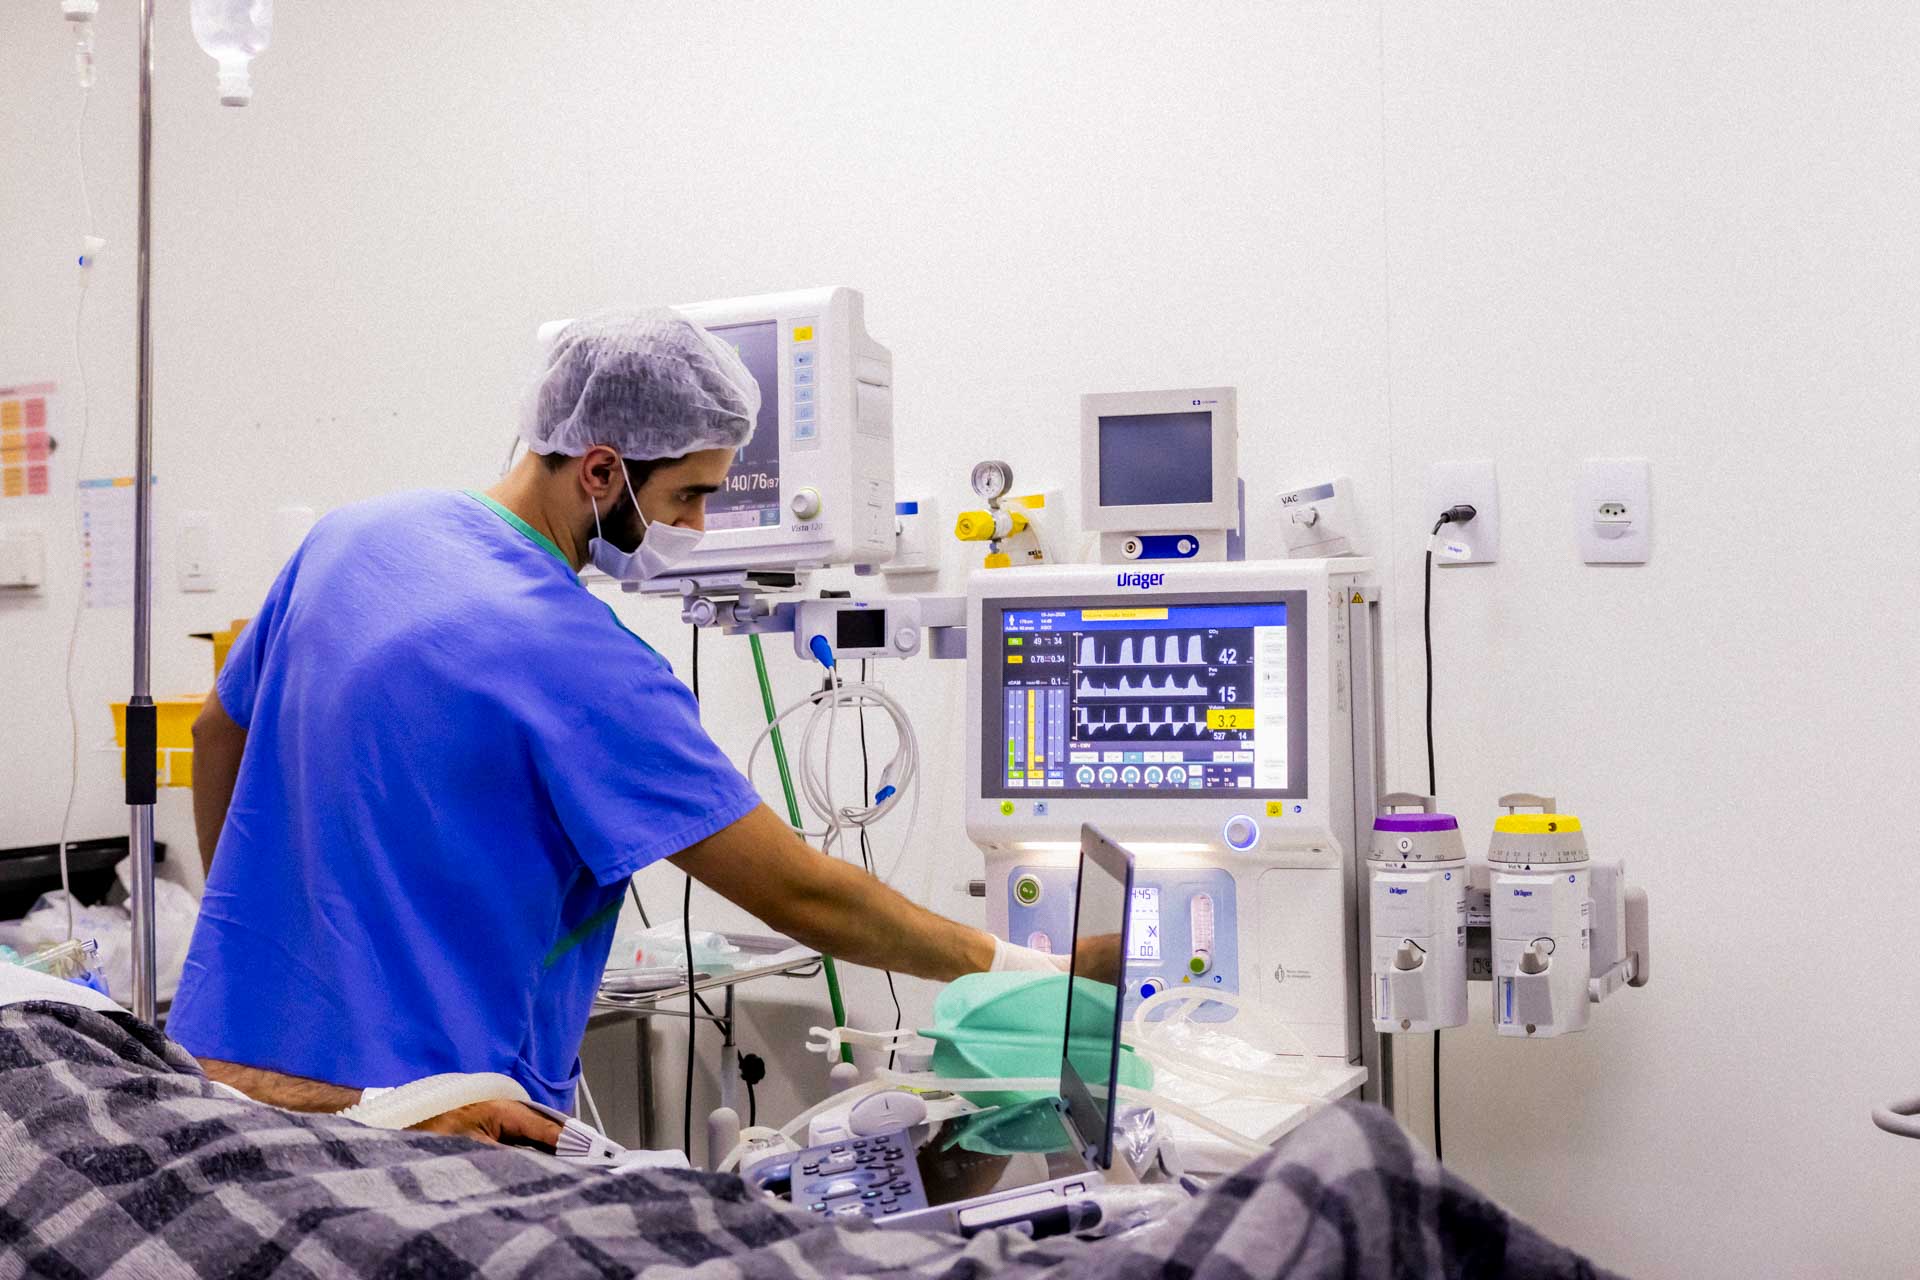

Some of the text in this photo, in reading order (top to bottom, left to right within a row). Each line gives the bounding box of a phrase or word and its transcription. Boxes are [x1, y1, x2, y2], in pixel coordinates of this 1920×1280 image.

[1281, 494, 1298, 505] VAC
[1219, 648, 1237, 665] 42
[1218, 686, 1236, 703] 15
[1218, 715, 1237, 728] 3.2
[1213, 732, 1226, 740] 527
[1238, 732, 1247, 740] 14
